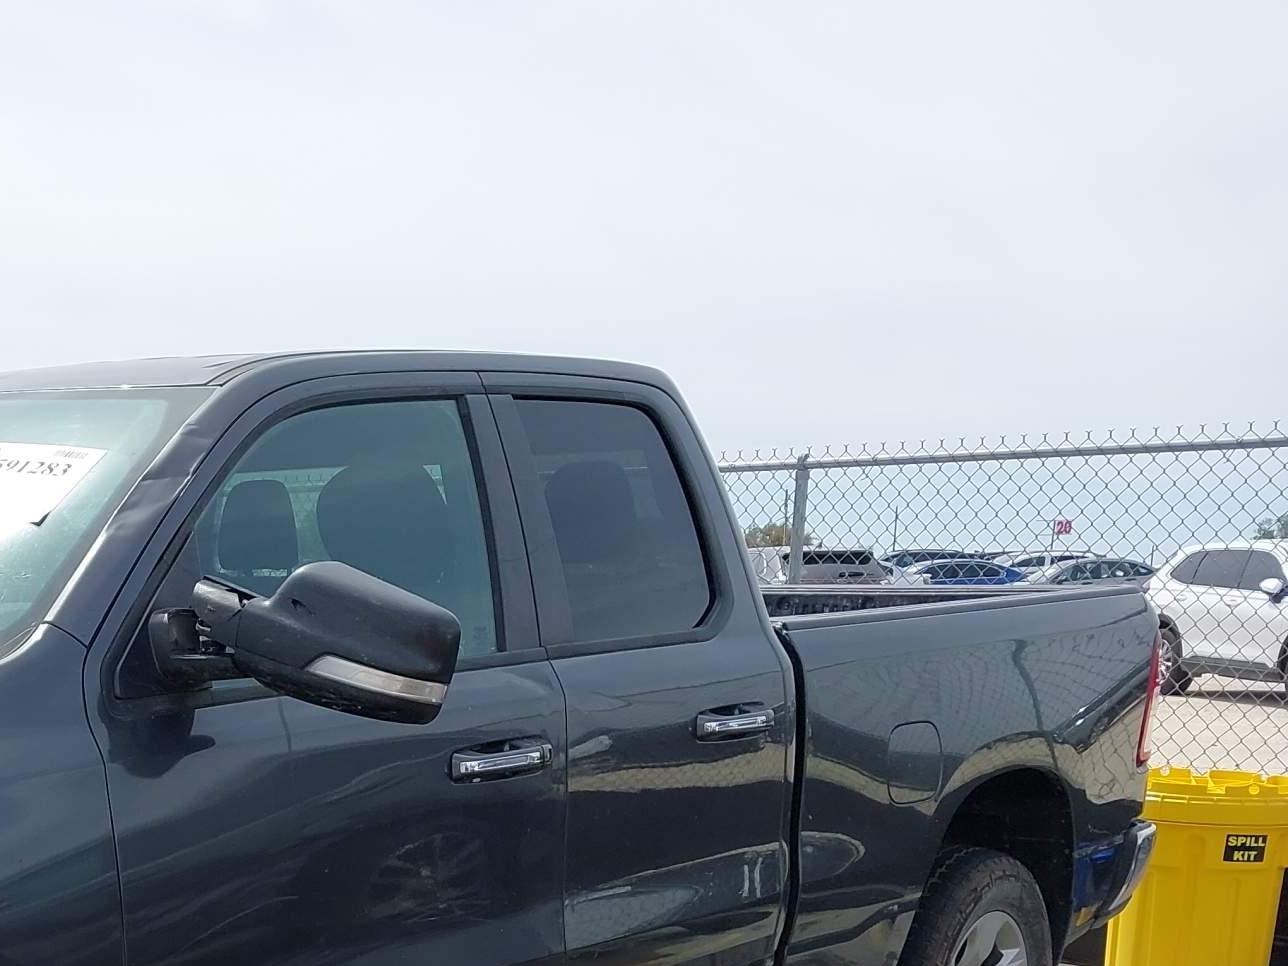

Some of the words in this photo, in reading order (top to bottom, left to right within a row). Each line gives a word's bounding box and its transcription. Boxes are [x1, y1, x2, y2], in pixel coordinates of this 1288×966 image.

[1056, 520, 1072, 534] 20
[1227, 835, 1266, 847] SPILL
[1232, 850, 1258, 861] KIT
